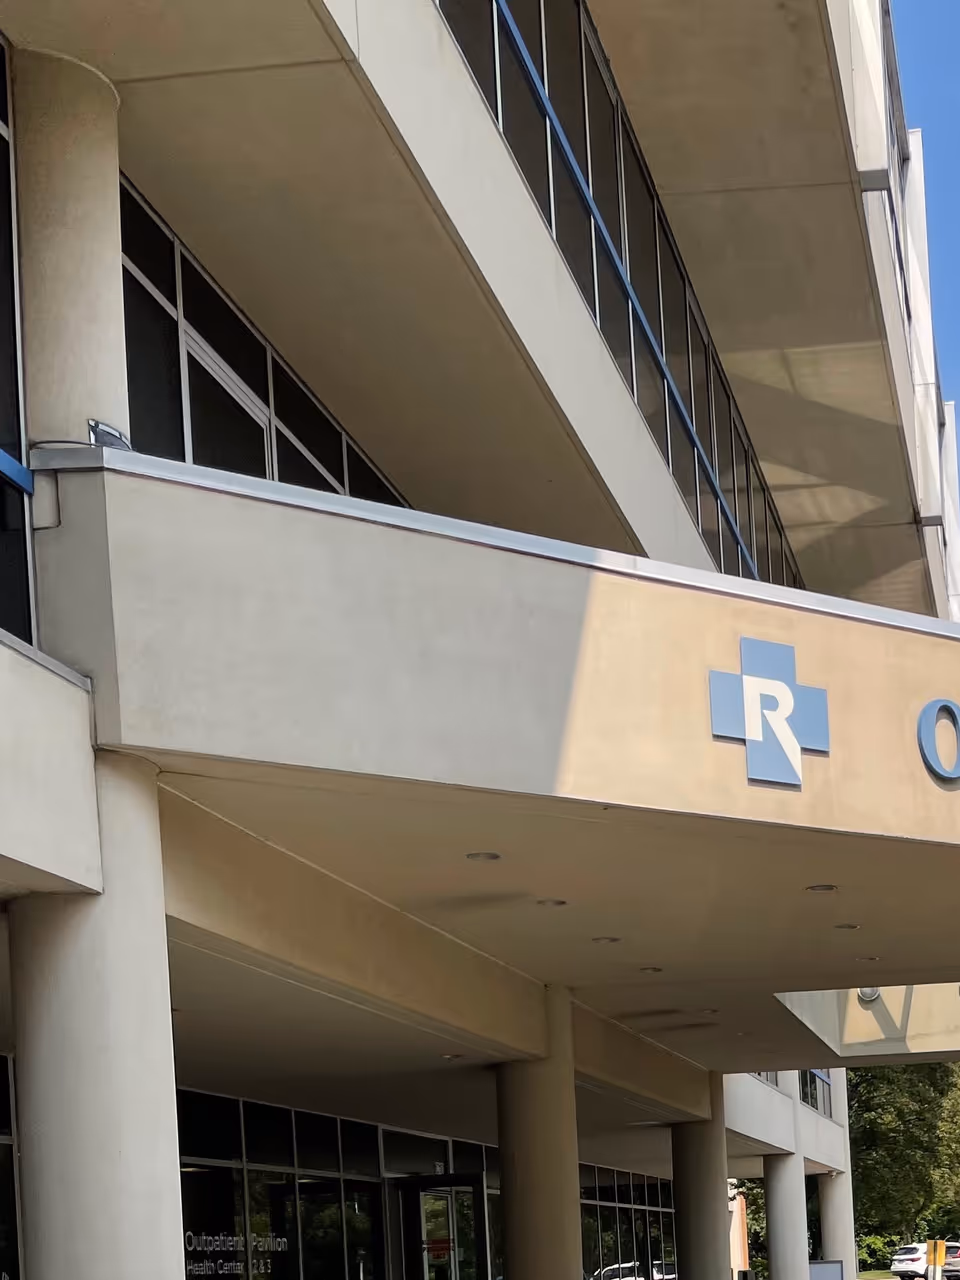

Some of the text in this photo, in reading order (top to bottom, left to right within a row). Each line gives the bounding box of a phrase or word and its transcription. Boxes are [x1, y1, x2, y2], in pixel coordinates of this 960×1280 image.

[742, 674, 803, 783] R
[185, 1231, 288, 1254] Outpatient Pavilion
[187, 1260, 215, 1275] Health
